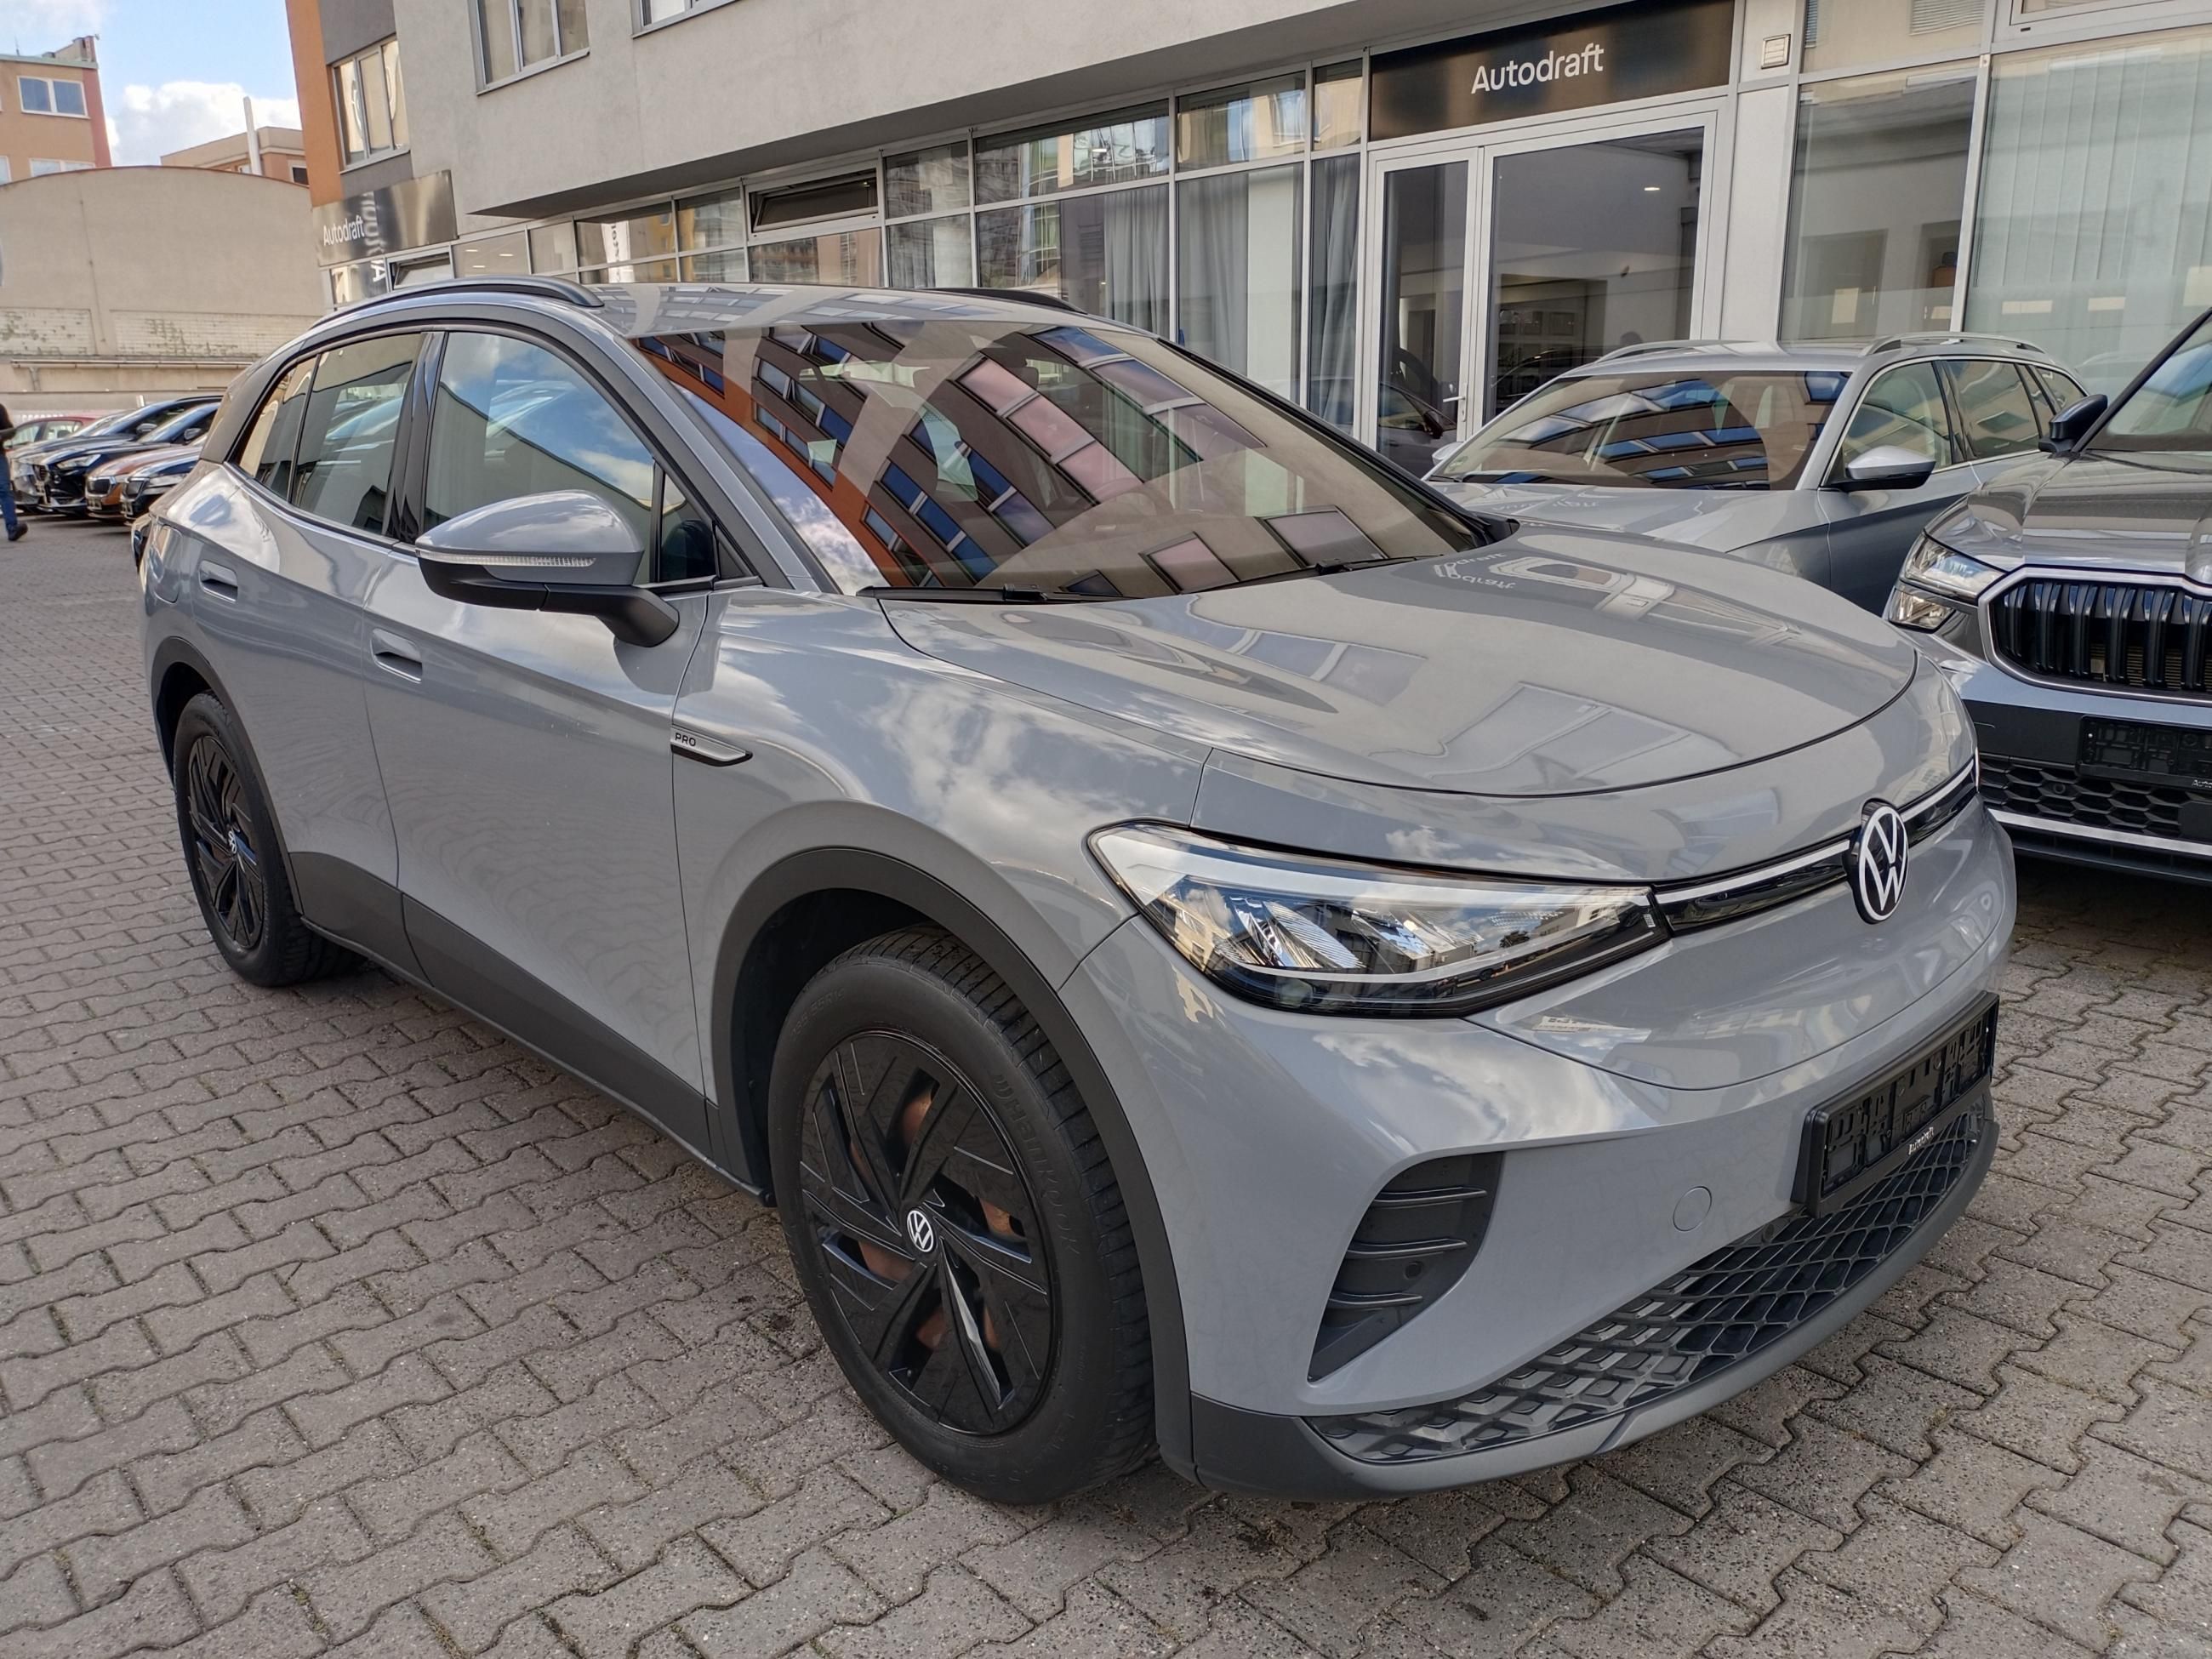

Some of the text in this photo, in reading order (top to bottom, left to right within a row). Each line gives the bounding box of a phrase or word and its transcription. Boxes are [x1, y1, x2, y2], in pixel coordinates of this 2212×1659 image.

[1471, 43, 1605, 94] Autodraft
[323, 214, 365, 246] Autodraft
[675, 733, 696, 746] PRO
